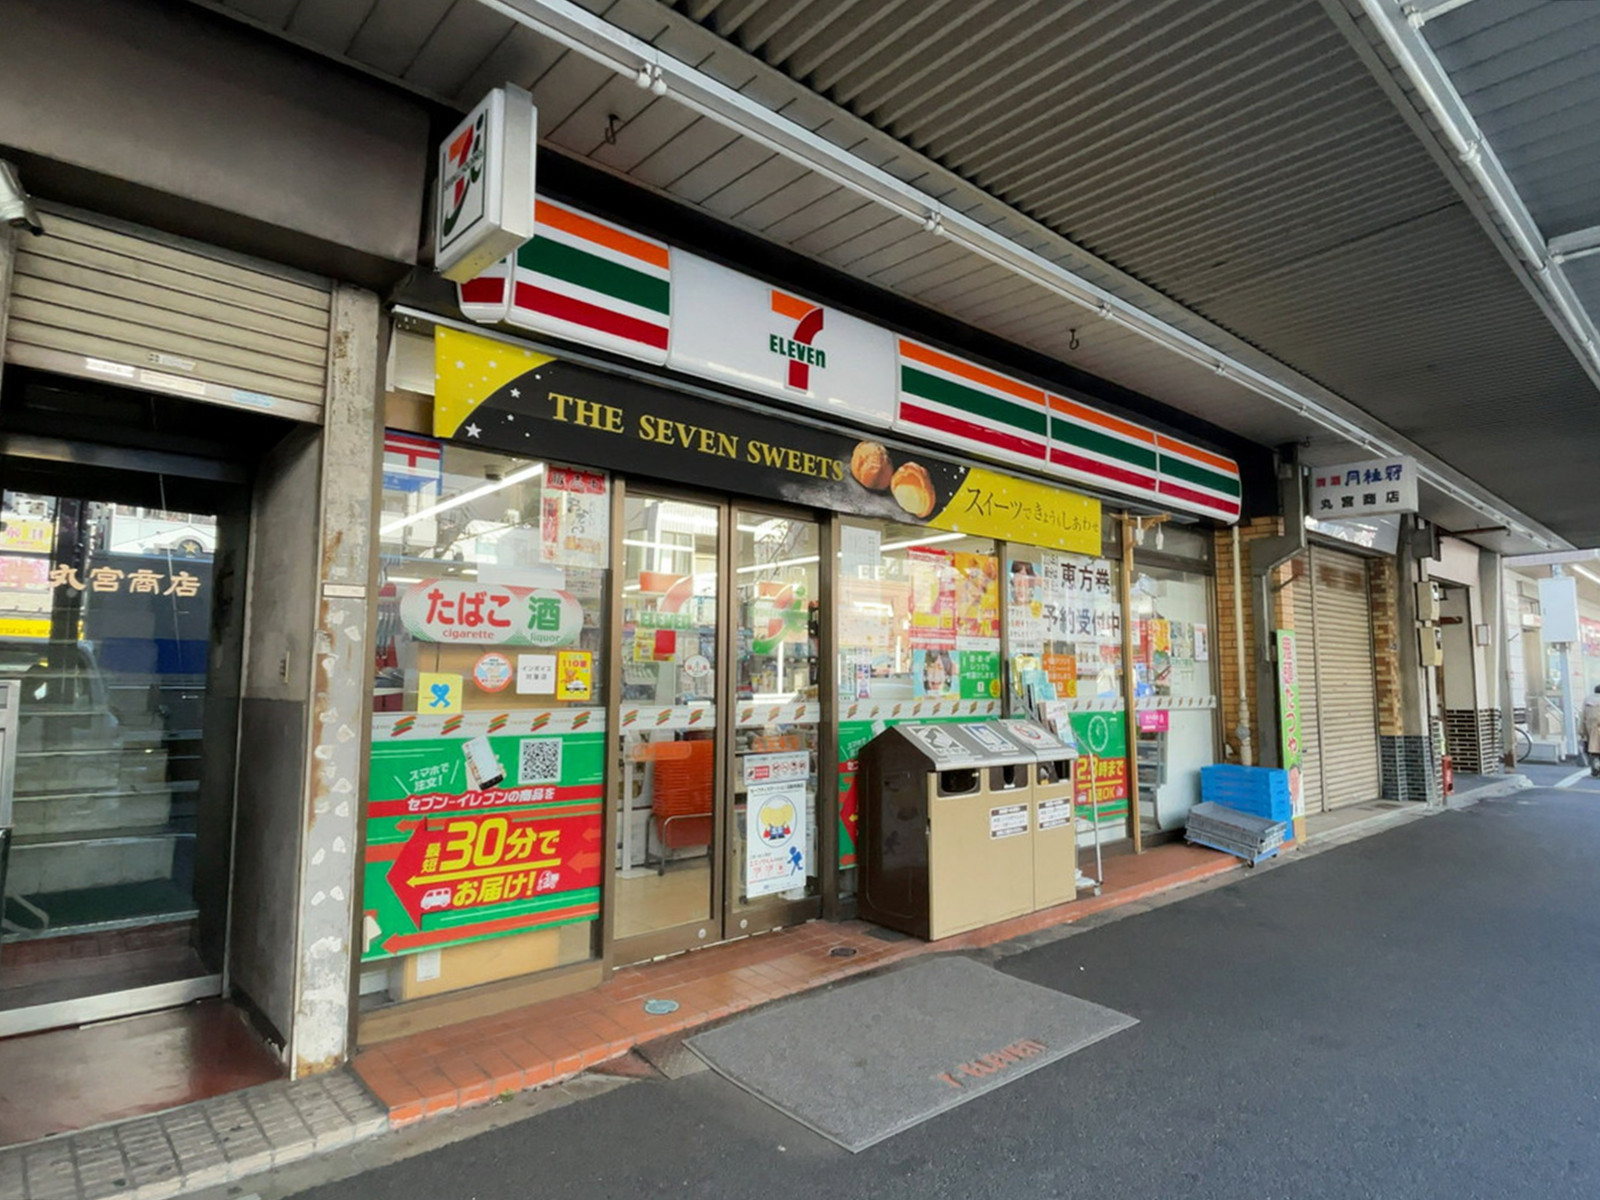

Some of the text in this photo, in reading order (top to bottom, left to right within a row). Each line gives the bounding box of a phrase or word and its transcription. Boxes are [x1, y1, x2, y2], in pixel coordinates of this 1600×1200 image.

[548, 392, 844, 482] THE SEVEN SWEETS
[1320, 490, 1400, 511] 丸宮商店
[50, 563, 201, 598] 丸宮商店
[425, 587, 561, 632] たばこ 酒
[442, 628, 561, 644] cigarette liquor
